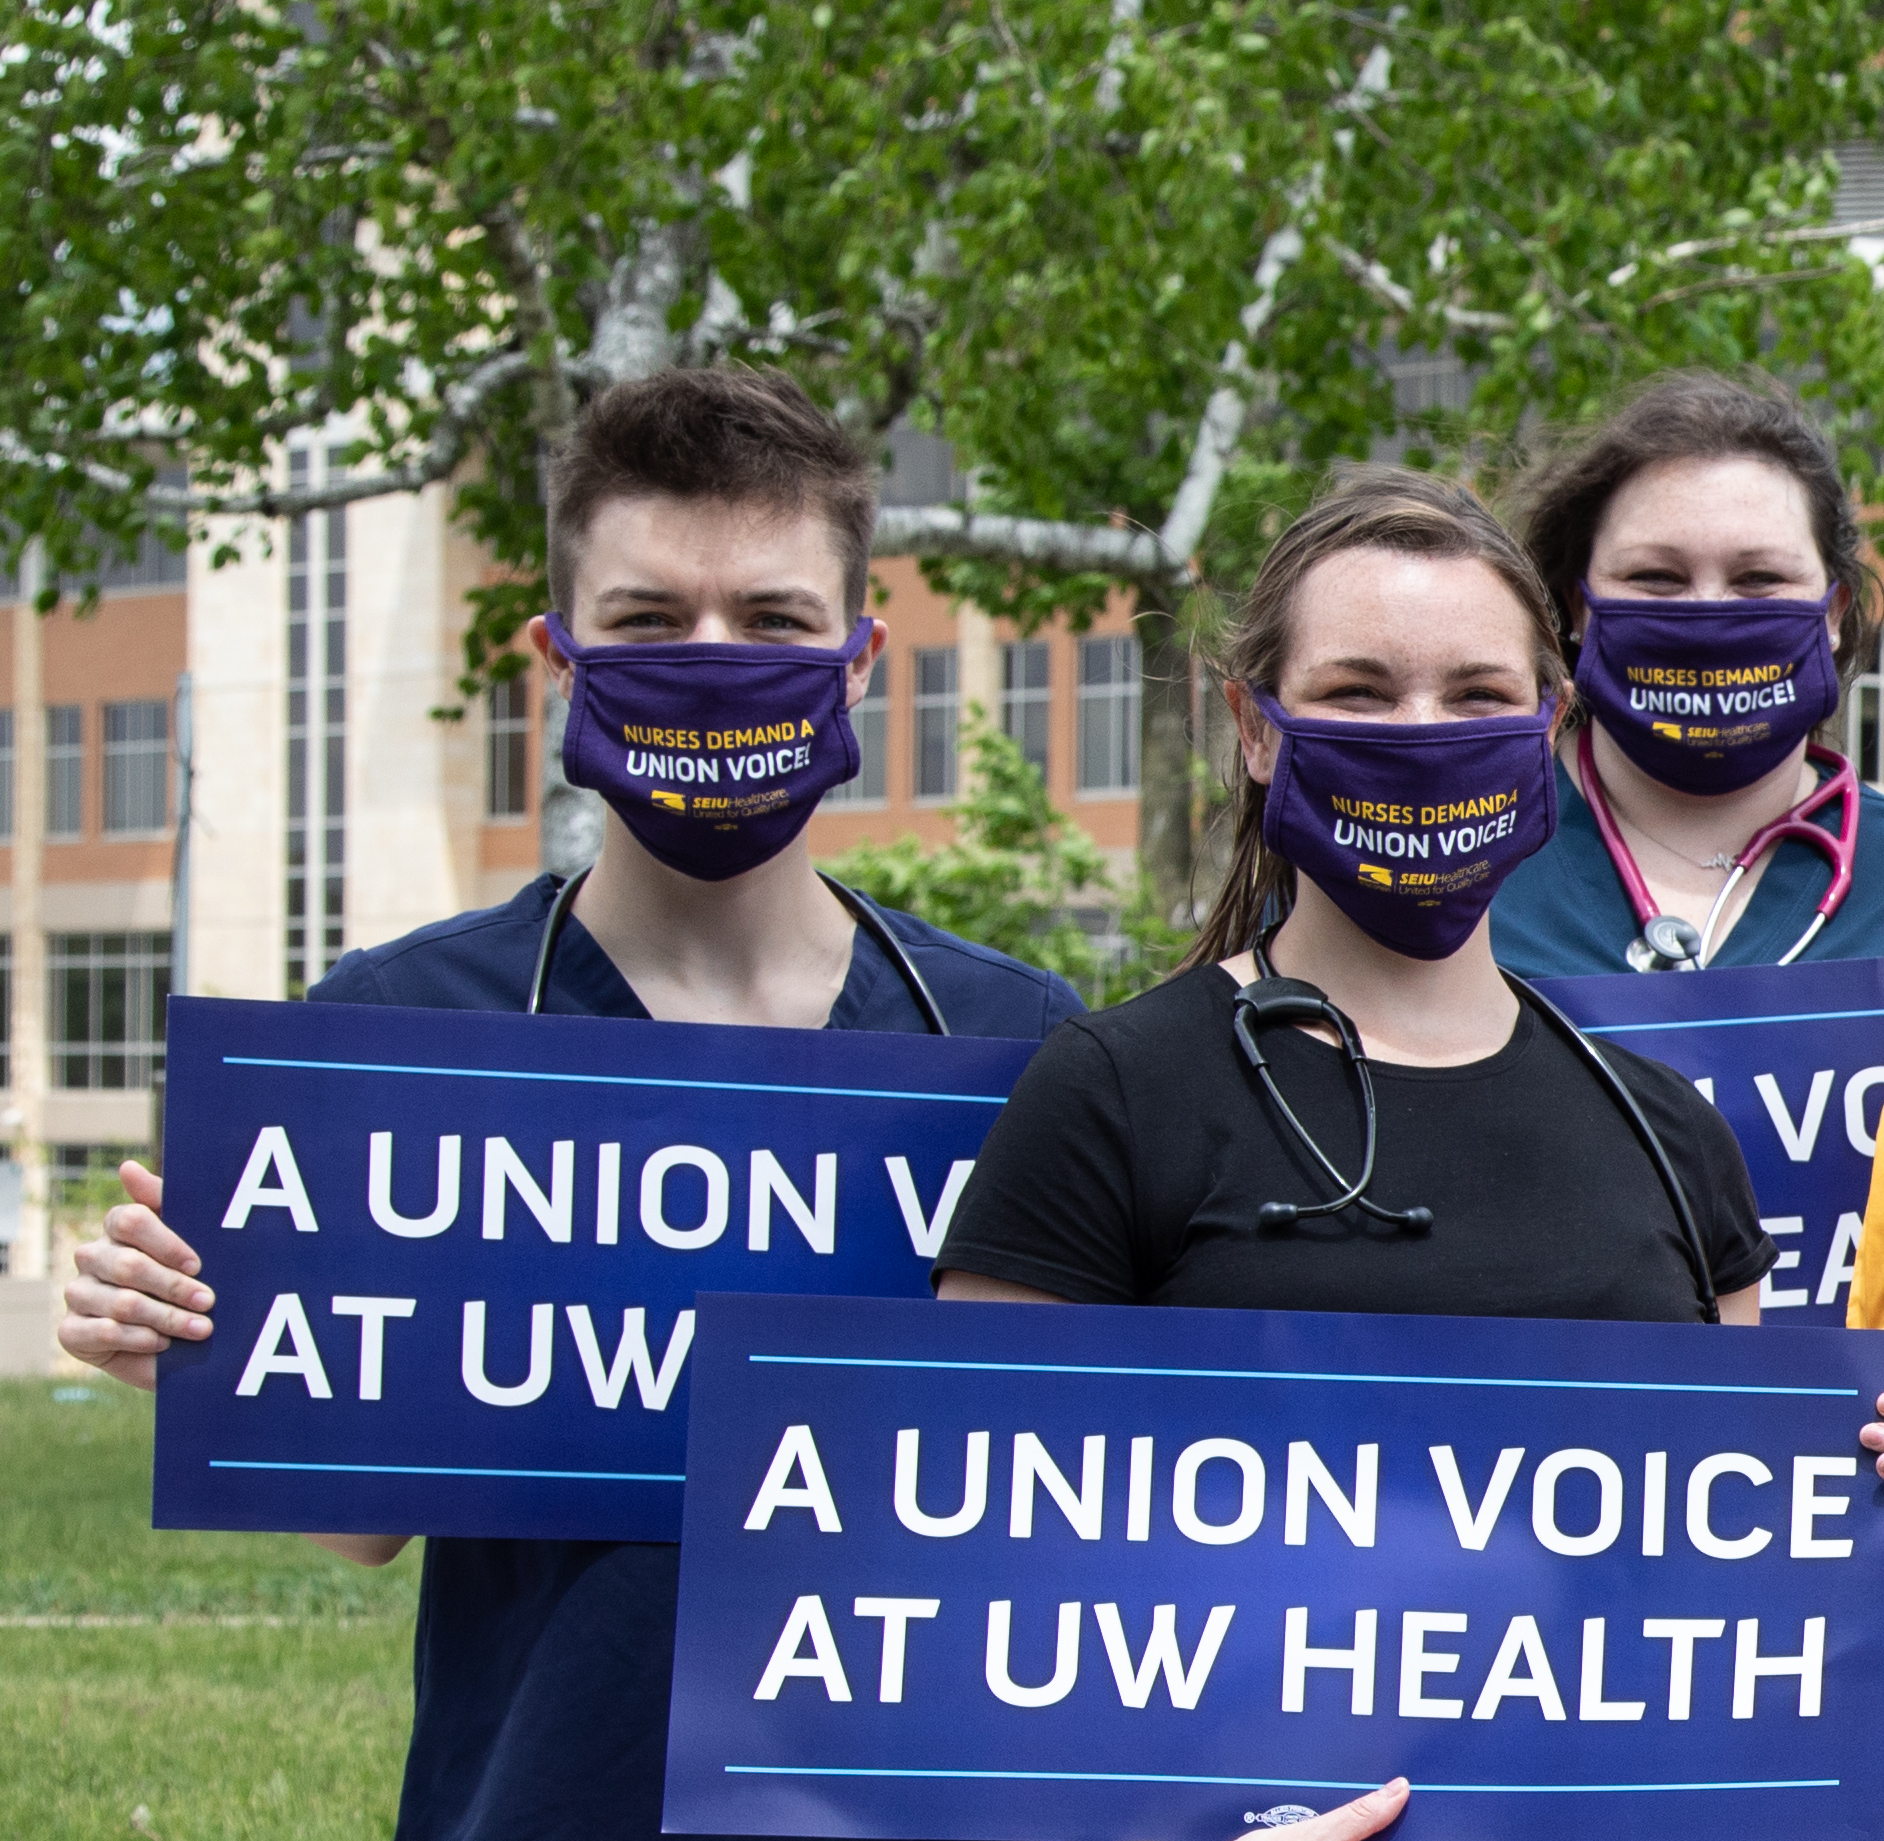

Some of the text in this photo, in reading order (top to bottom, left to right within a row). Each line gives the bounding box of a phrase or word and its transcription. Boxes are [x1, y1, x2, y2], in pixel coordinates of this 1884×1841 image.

[1627, 666, 1697, 687] NURSES
[1702, 664, 1781, 687] DEMAND
[1630, 679, 1796, 716] UNION VOICE!
[623, 719, 815, 750] NURSES DEMAND A
[626, 742, 811, 783] UNION VOICE!
[1332, 789, 1518, 825] NURSES DEMAND A
[1333, 810, 1517, 858] UNION VOICE!
[221, 1126, 319, 1232] A
[367, 1130, 837, 1255] UNION
[235, 1293, 696, 1412] AT UW
[743, 1424, 1859, 1561] A UNION VOICE
[753, 1593, 1827, 1721] AT UW HEALTH
